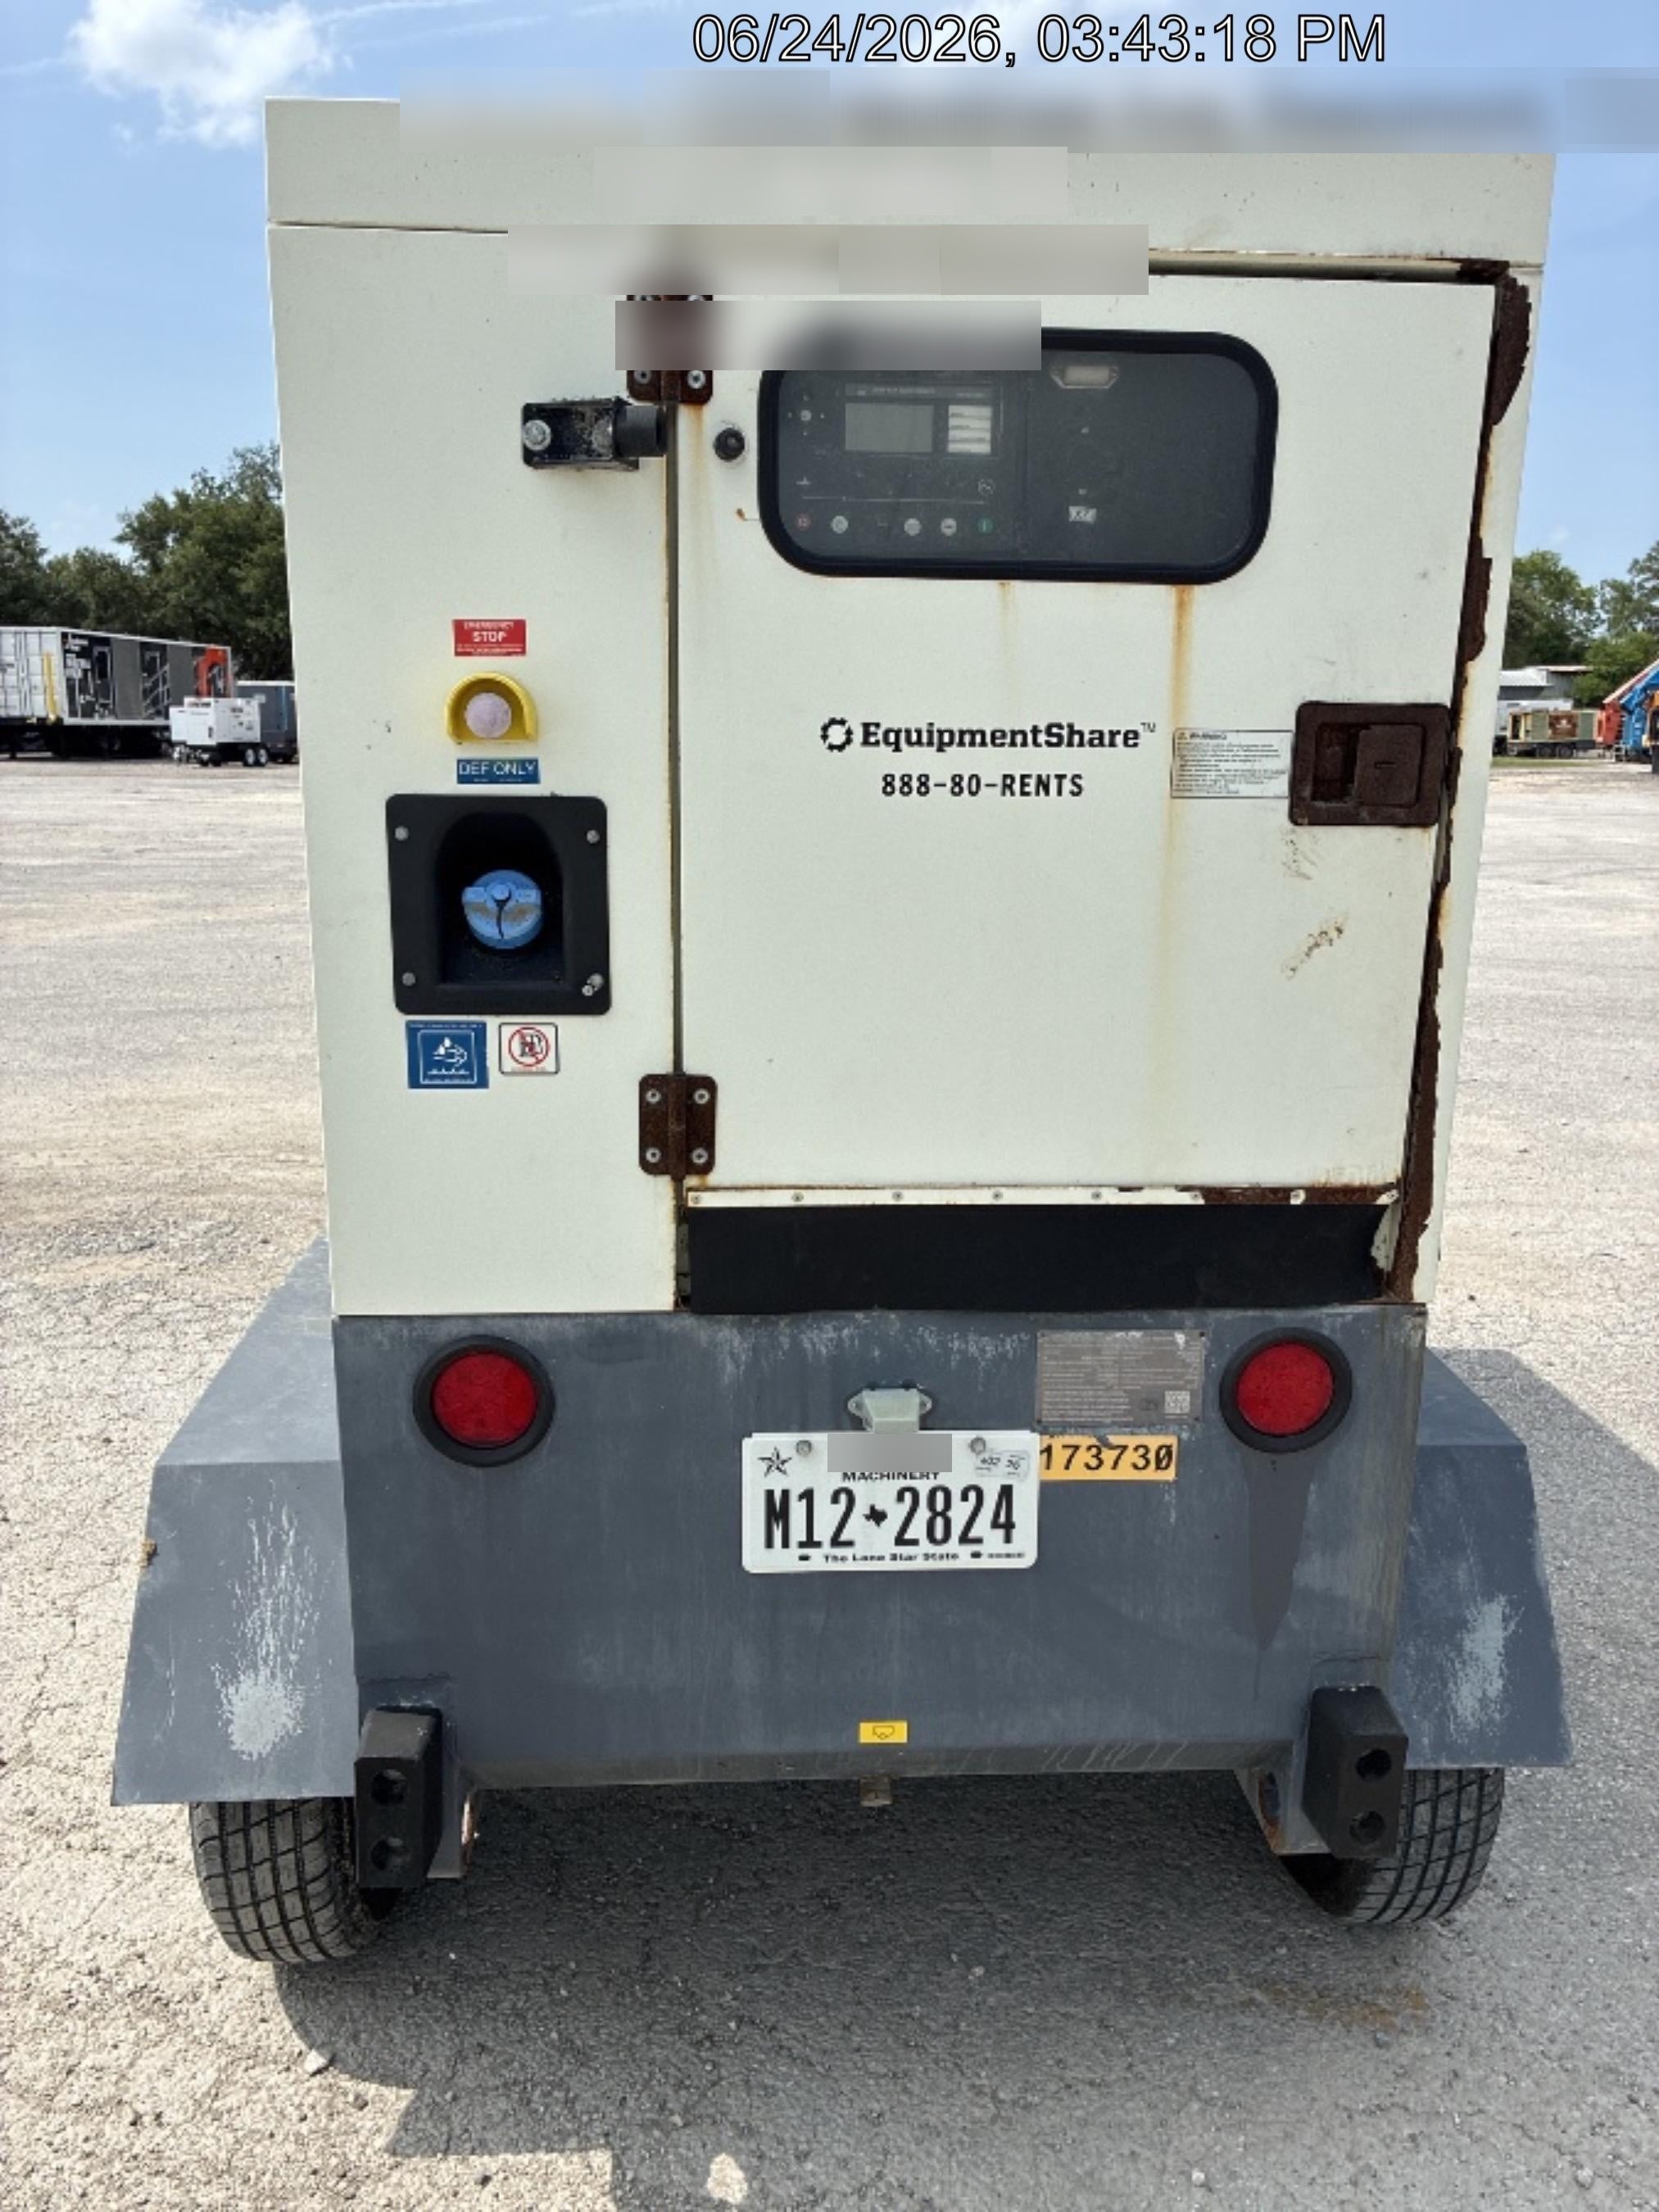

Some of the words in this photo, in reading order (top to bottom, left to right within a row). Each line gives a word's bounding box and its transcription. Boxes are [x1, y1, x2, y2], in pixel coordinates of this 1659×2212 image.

[472, 630, 507, 643] STOP
[458, 761, 490, 775] DEF
[493, 760, 537, 775] ONLY
[881, 773, 1085, 798] 888-80-RENTS
[1040, 1443, 1174, 1471] 173730
[894, 1484, 1017, 1547] 2824
[823, 1553, 848, 1563] The
[852, 1552, 886, 1562] Lone
[889, 1552, 919, 1562] Star
[922, 1551, 959, 1562] State
